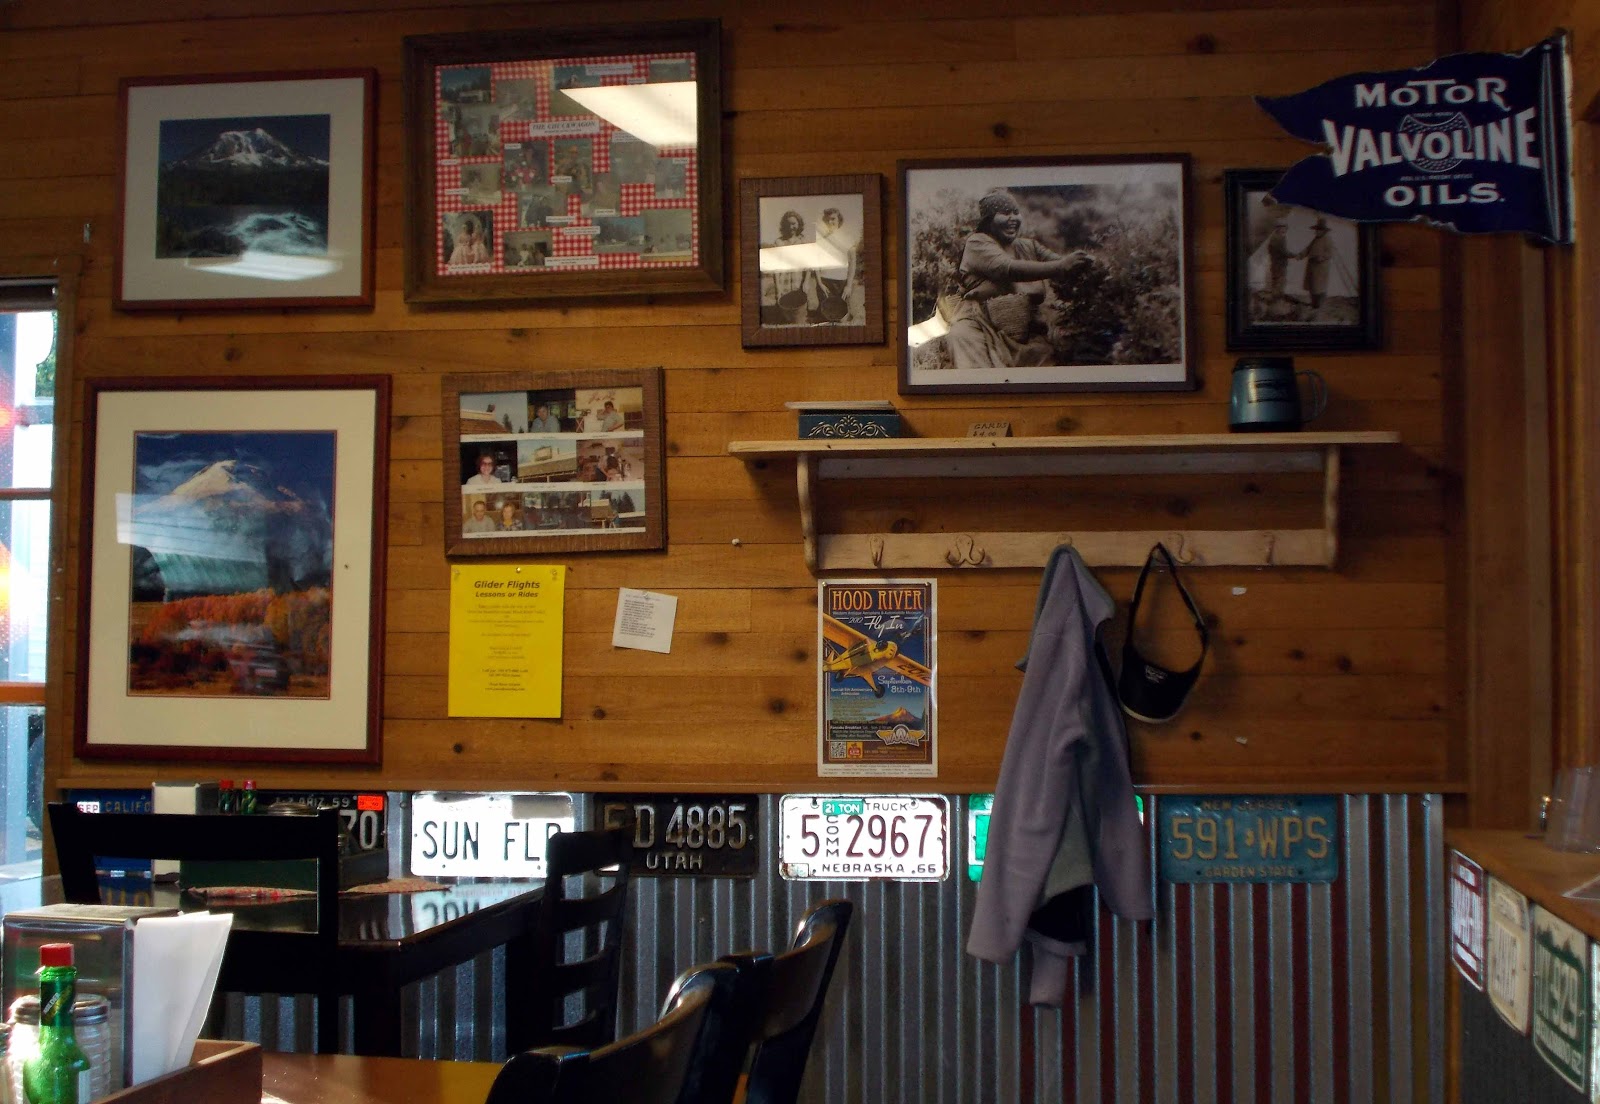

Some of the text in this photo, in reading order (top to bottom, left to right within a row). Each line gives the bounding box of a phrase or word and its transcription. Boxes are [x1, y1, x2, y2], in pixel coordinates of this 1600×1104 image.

[1354, 77, 1511, 112] MOTOR
[1321, 107, 1542, 178] VALVOLINE
[1383, 182, 1506, 207] OILS.
[474, 580, 540, 590] Glider Flights
[832, 590, 923, 611] HOOD RIVER
[864, 615, 886, 638] Fly
[886, 615, 904, 631] In
[877, 675, 912, 688] September
[78, 803, 99, 813] SEP
[105, 801, 150, 813] CALIFO
[333, 797, 350, 808] 59
[838, 802, 861, 814] TON
[866, 802, 910, 811] TRUCK
[1201, 801, 1297, 812] NEW JERSEY
[665, 804, 747, 849] 4885
[422, 820, 479, 861] SUN
[801, 814, 820, 858] 5
[845, 814, 933, 858] 2967
[1172, 816, 1329, 860] 591 WPS
[646, 852, 702, 869] UTAH
[822, 863, 905, 873] NEBRASKA
[1205, 866, 1297, 878] GARDEN STATE
